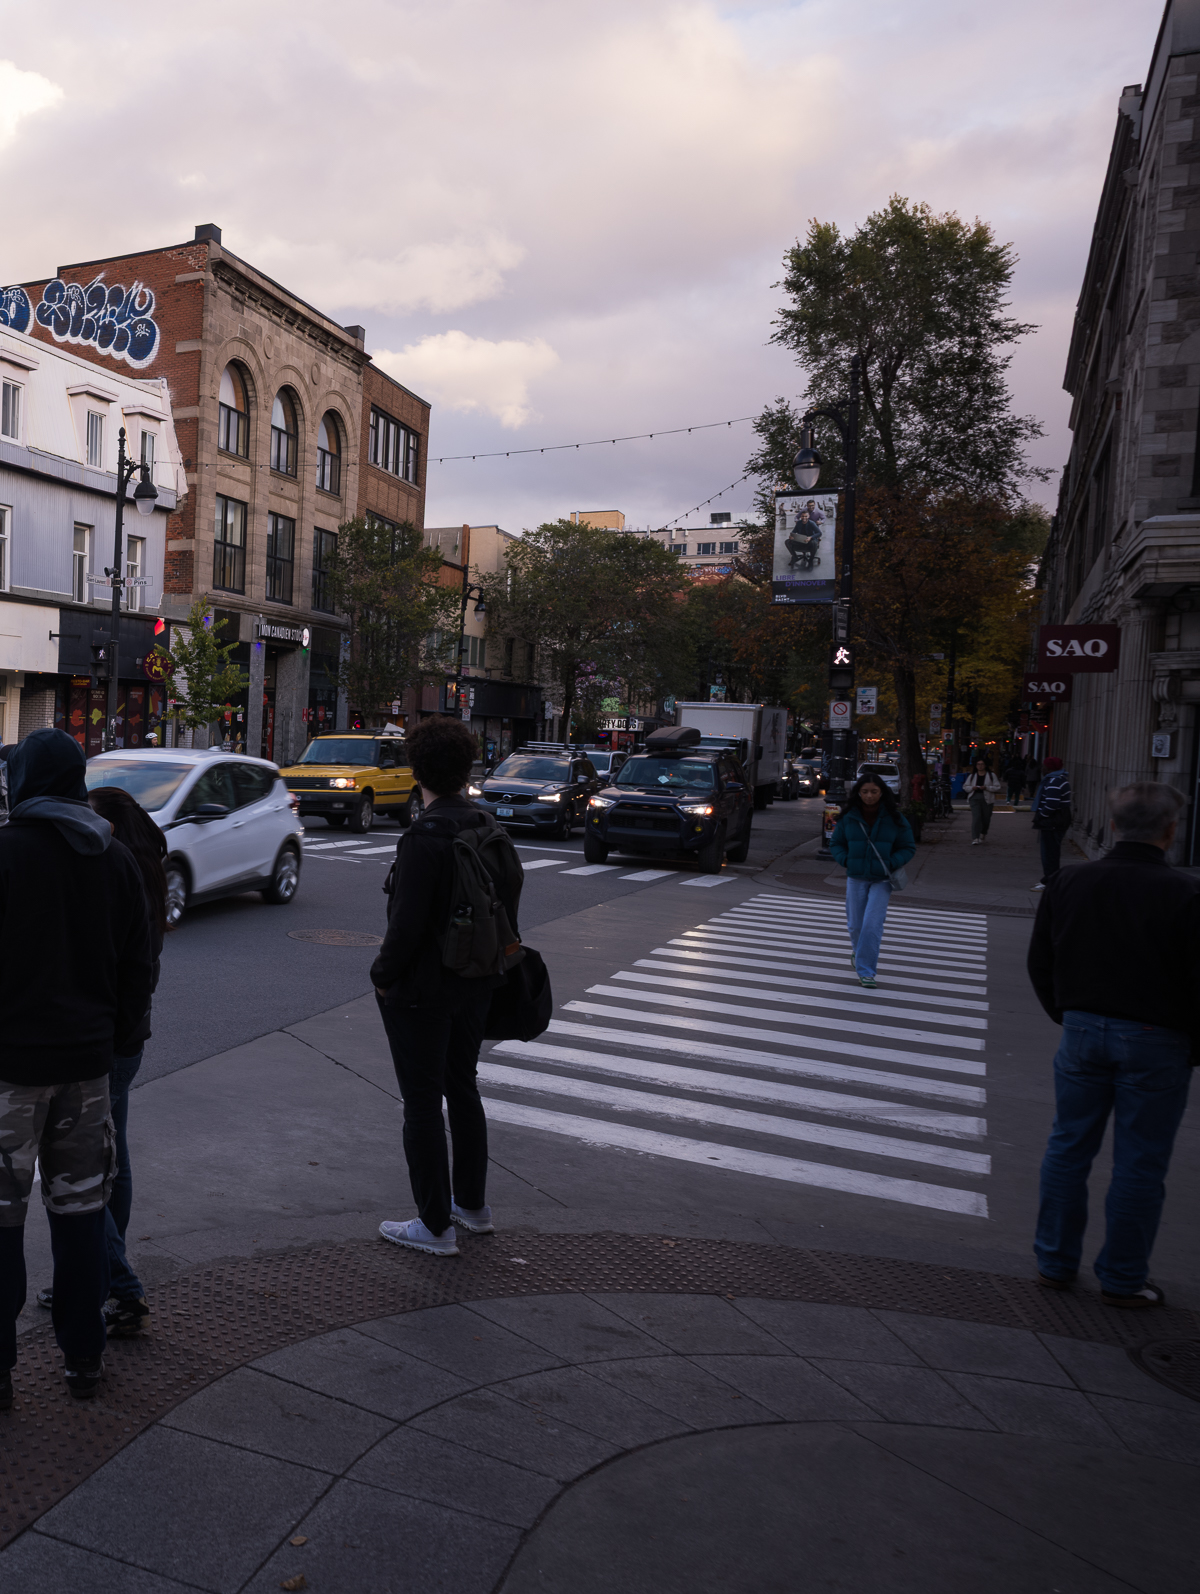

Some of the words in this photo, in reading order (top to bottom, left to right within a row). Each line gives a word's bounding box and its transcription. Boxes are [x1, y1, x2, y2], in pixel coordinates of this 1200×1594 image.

[1046, 639, 1109, 658] SAQ
[1028, 681, 1066, 694] SAQ
[618, 719, 637, 728] DOS
